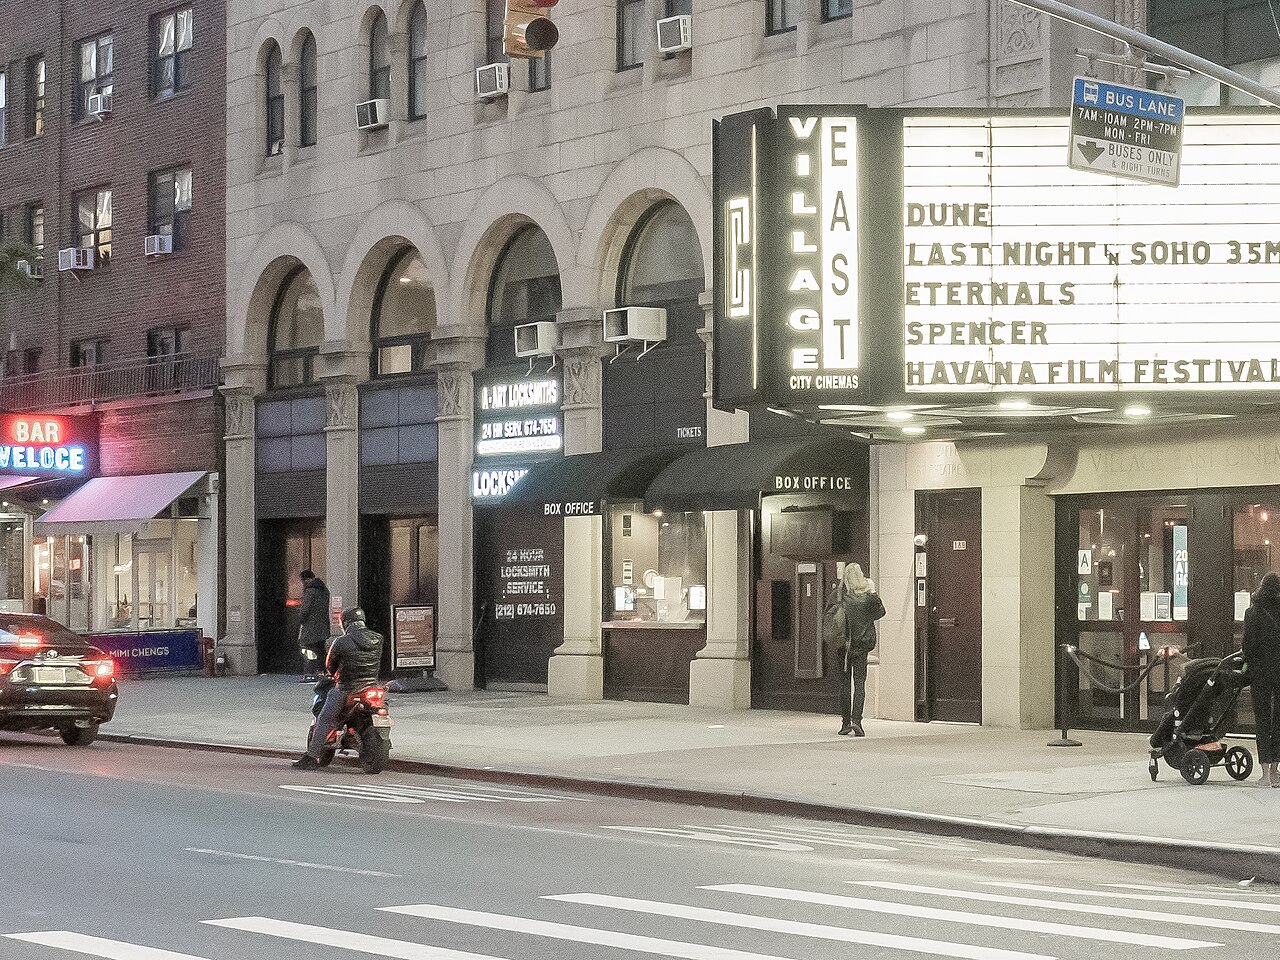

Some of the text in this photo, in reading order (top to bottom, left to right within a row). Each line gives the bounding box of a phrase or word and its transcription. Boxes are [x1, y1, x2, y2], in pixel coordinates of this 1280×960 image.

[1105, 90, 1177, 117] BUS LANE
[1104, 126, 1125, 140] MON
[1135, 132, 1151, 145] FRI
[1134, 118, 1177, 136] 2PM-7PM
[1108, 143, 1175, 167] BUSES ONLY
[1121, 161, 1143, 173] RIGHT
[1147, 165, 1170, 178] TURNS
[907, 203, 989, 227] DUNE
[788, 117, 820, 370] VILLAGE
[830, 125, 851, 360] EAST
[908, 243, 990, 266] LAST
[1003, 241, 1096, 266] NIGHT
[1131, 240, 1211, 266] SOHO
[906, 282, 1076, 306] ETERNALS
[907, 321, 1049, 345] SPENCER
[790, 374, 859, 389] CITY CINEMAS
[907, 360, 1037, 385] HAVANA
[1048, 359, 1119, 384] FILM
[16, 421, 60, 443] BAR
[677, 426, 702, 438] TICKETS
[775, 476, 851, 490] BOX OFFICE
[544, 501, 594, 515] BOX OFFICE
[1081, 553, 1089, 568] A
[507, 581, 544, 594] SERVICE
[109, 649, 129, 657] MIMI
